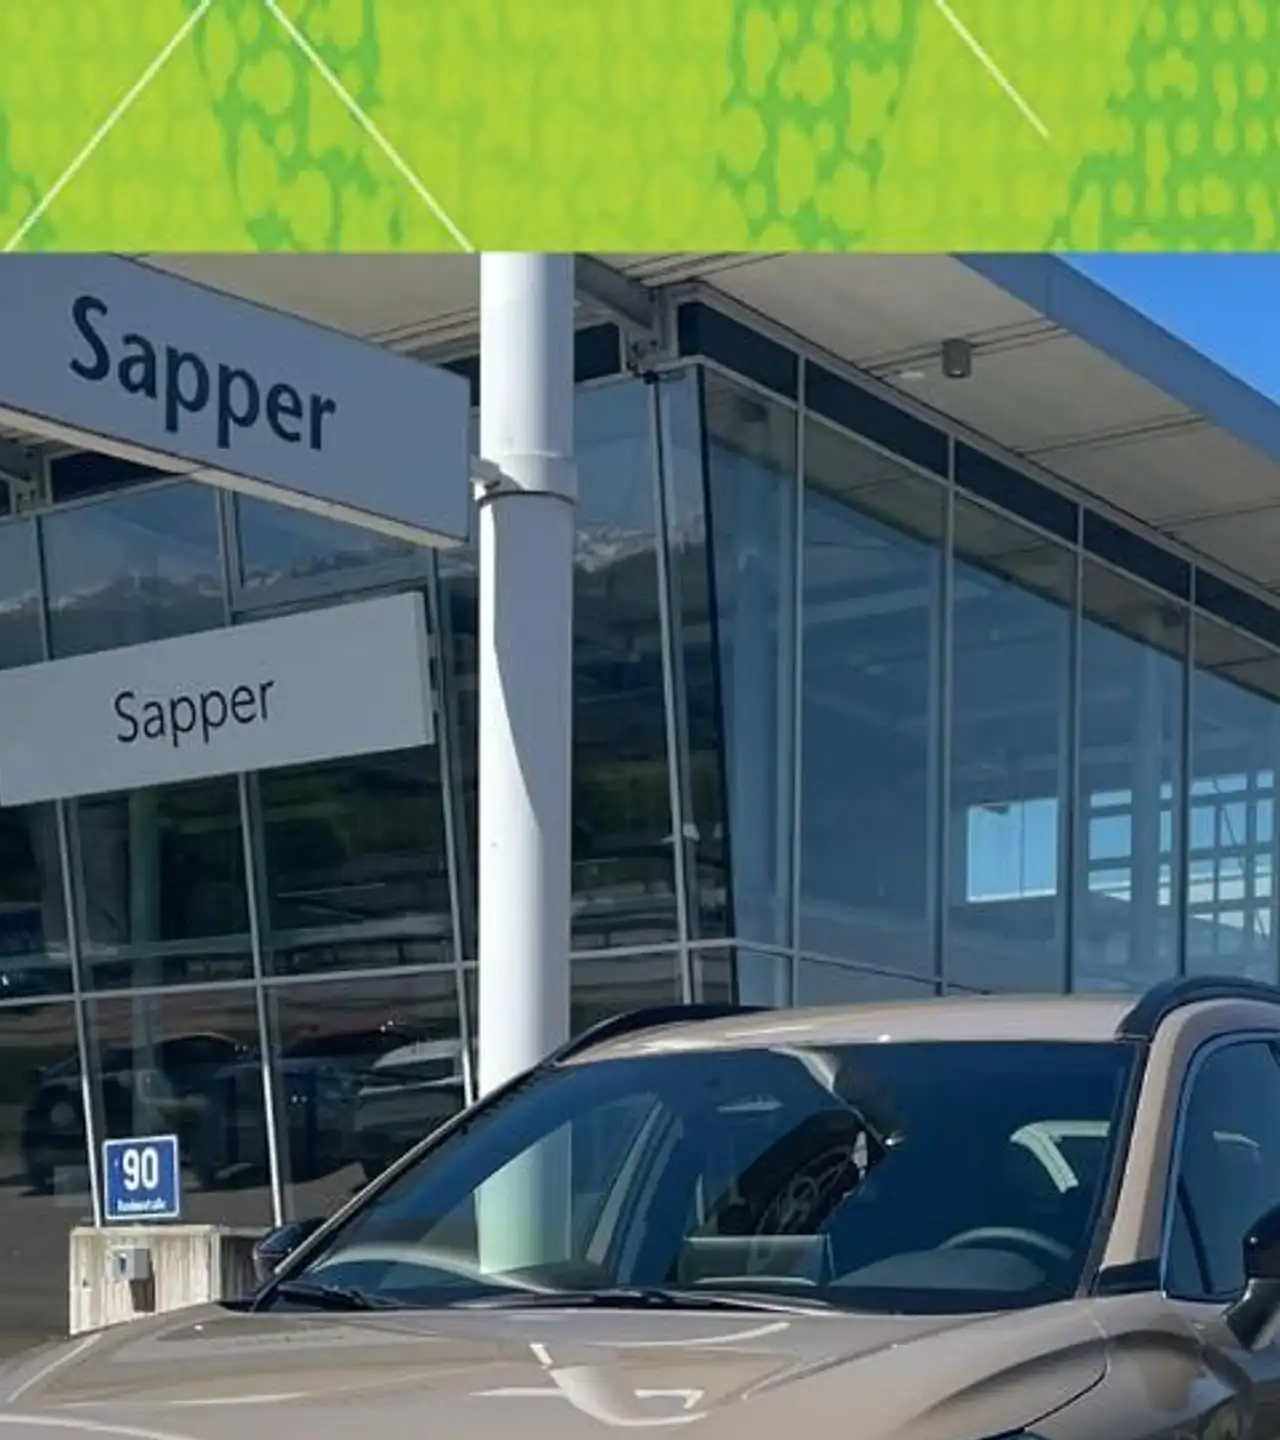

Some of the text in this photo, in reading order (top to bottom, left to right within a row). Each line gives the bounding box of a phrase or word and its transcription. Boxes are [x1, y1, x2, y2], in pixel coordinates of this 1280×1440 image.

[68, 295, 337, 451] Sapper
[113, 679, 276, 749] Sapper
[122, 1146, 160, 1192] 90
